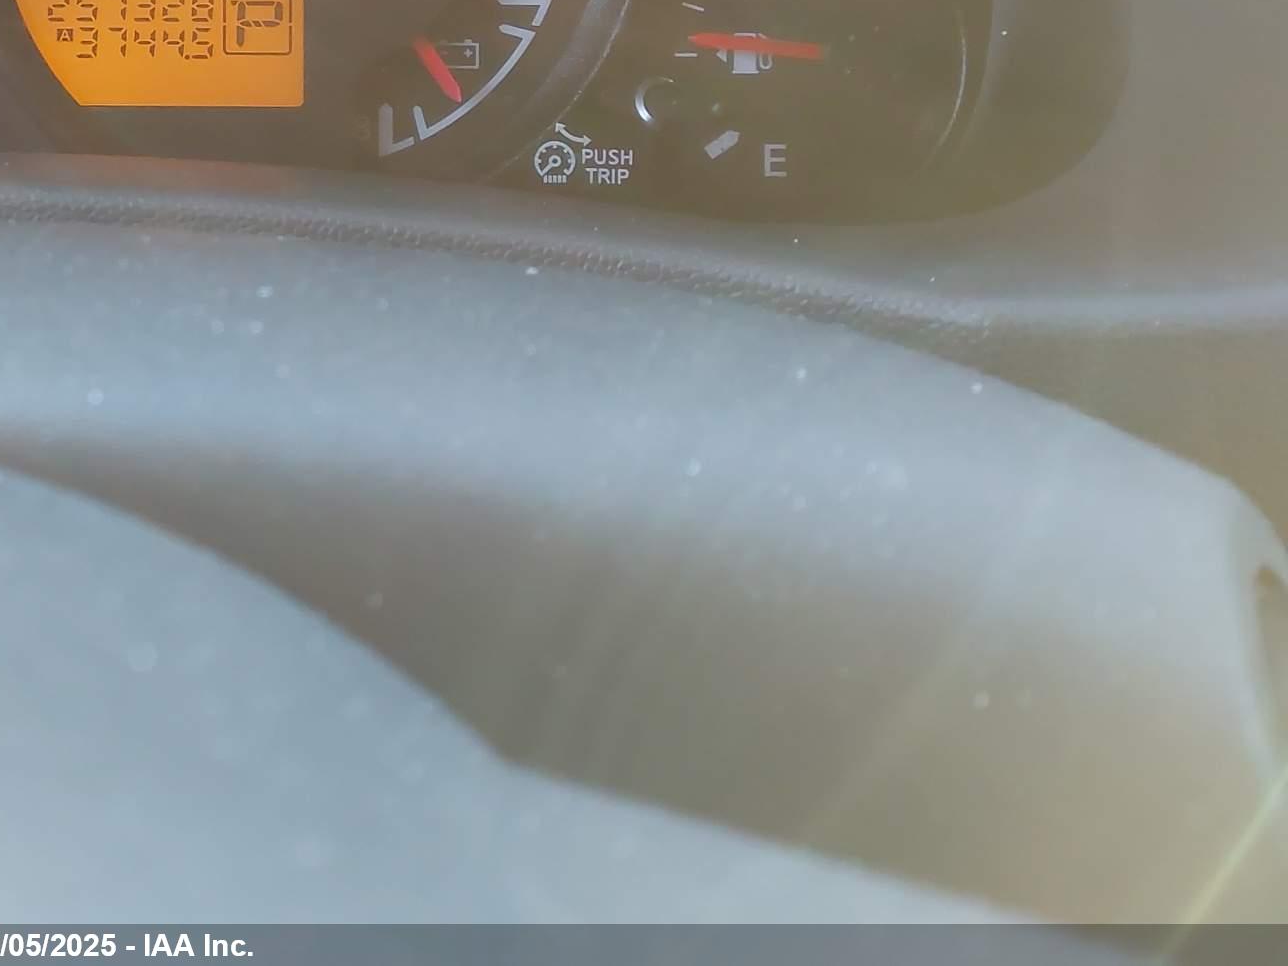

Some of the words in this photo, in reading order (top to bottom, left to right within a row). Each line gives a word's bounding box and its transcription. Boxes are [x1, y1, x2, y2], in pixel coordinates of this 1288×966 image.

[231, 1, 283, 48] P
[581, 149, 634, 166] PUSH
[765, 144, 787, 177] E
[587, 168, 630, 185] TRIP
